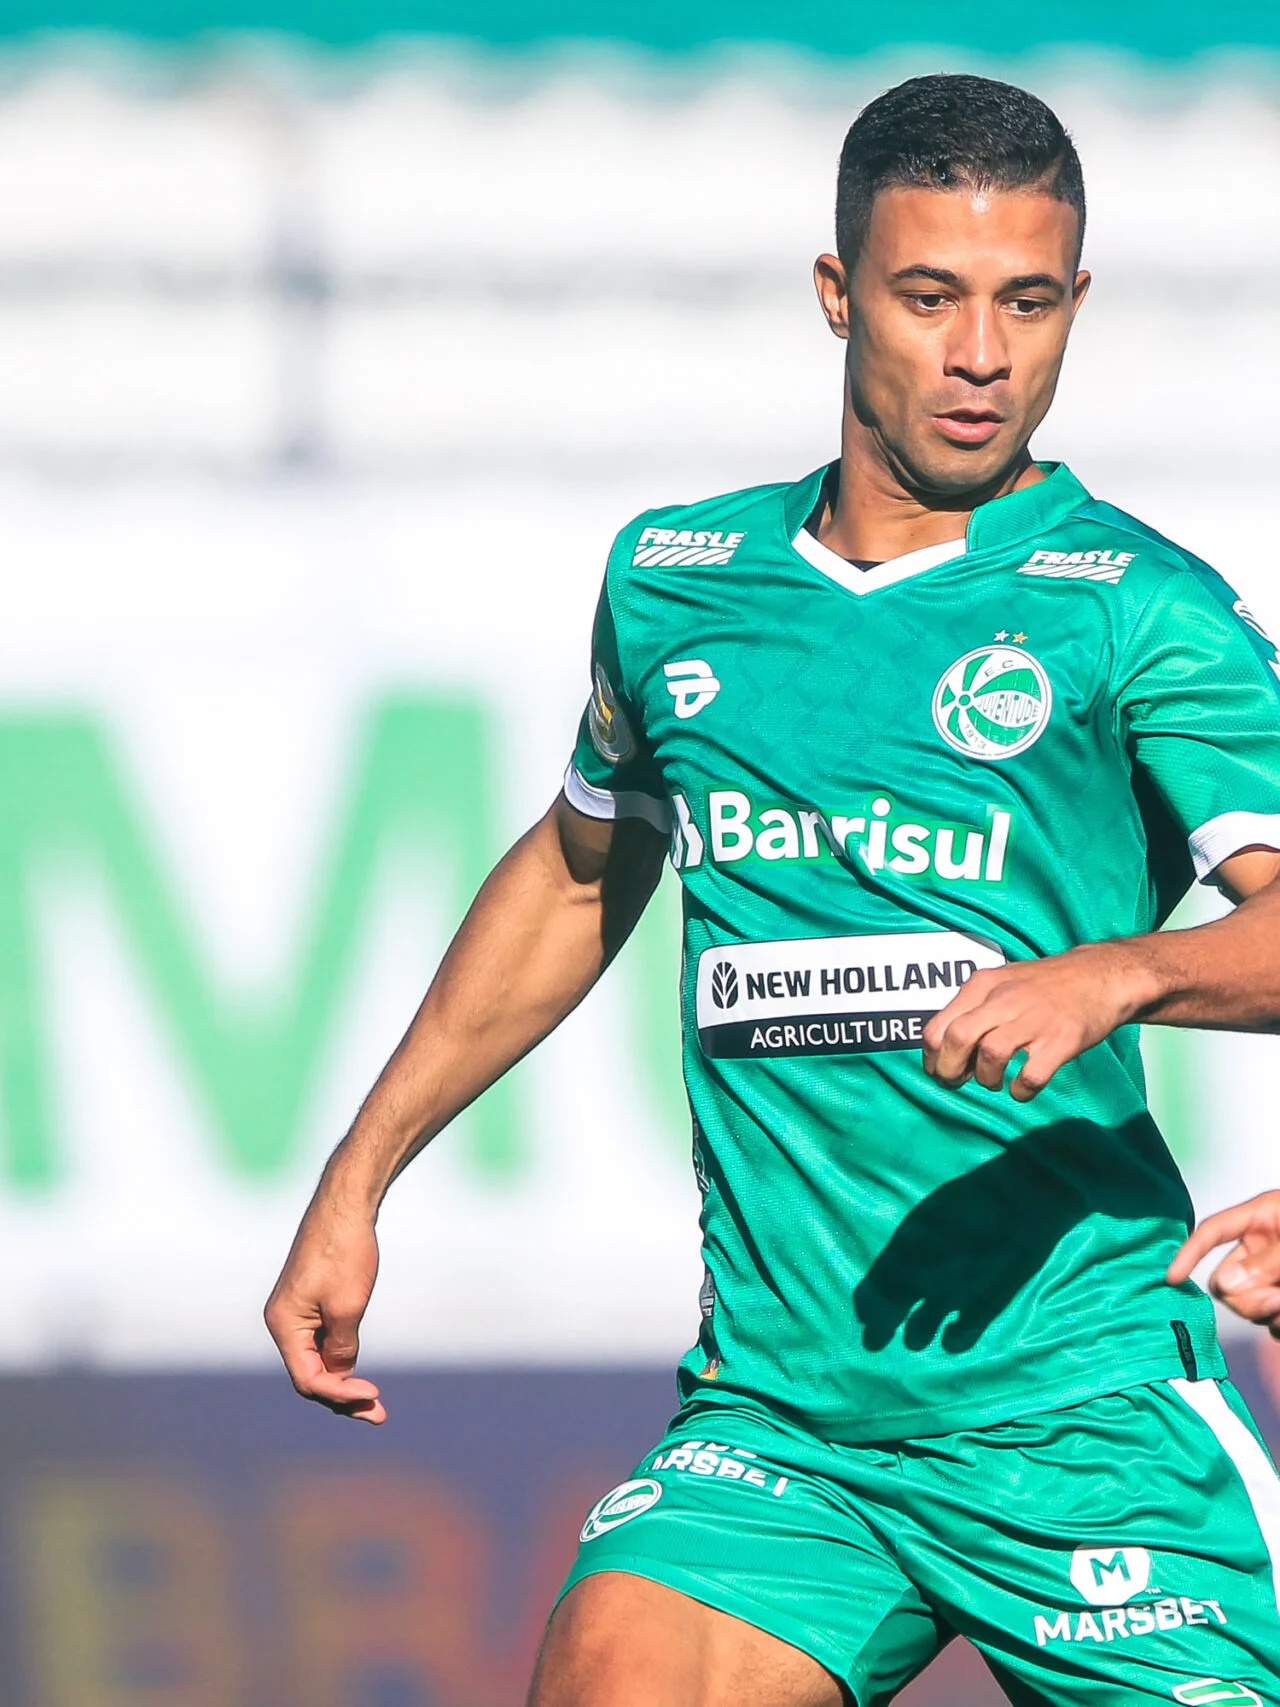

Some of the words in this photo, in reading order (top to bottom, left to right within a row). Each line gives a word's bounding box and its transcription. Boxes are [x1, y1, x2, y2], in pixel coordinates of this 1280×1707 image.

[638, 527, 746, 549] FRASLE
[1027, 549, 1137, 568] FRASLE
[708, 790, 1012, 883] Banrisul
[745, 969, 812, 1000] NEW
[820, 959, 977, 996] HOLLAND
[750, 1017, 923, 1050] AGRICULTURE
[1089, 1550, 1132, 1587] M
[1033, 1597, 1228, 1647] MARSBET
